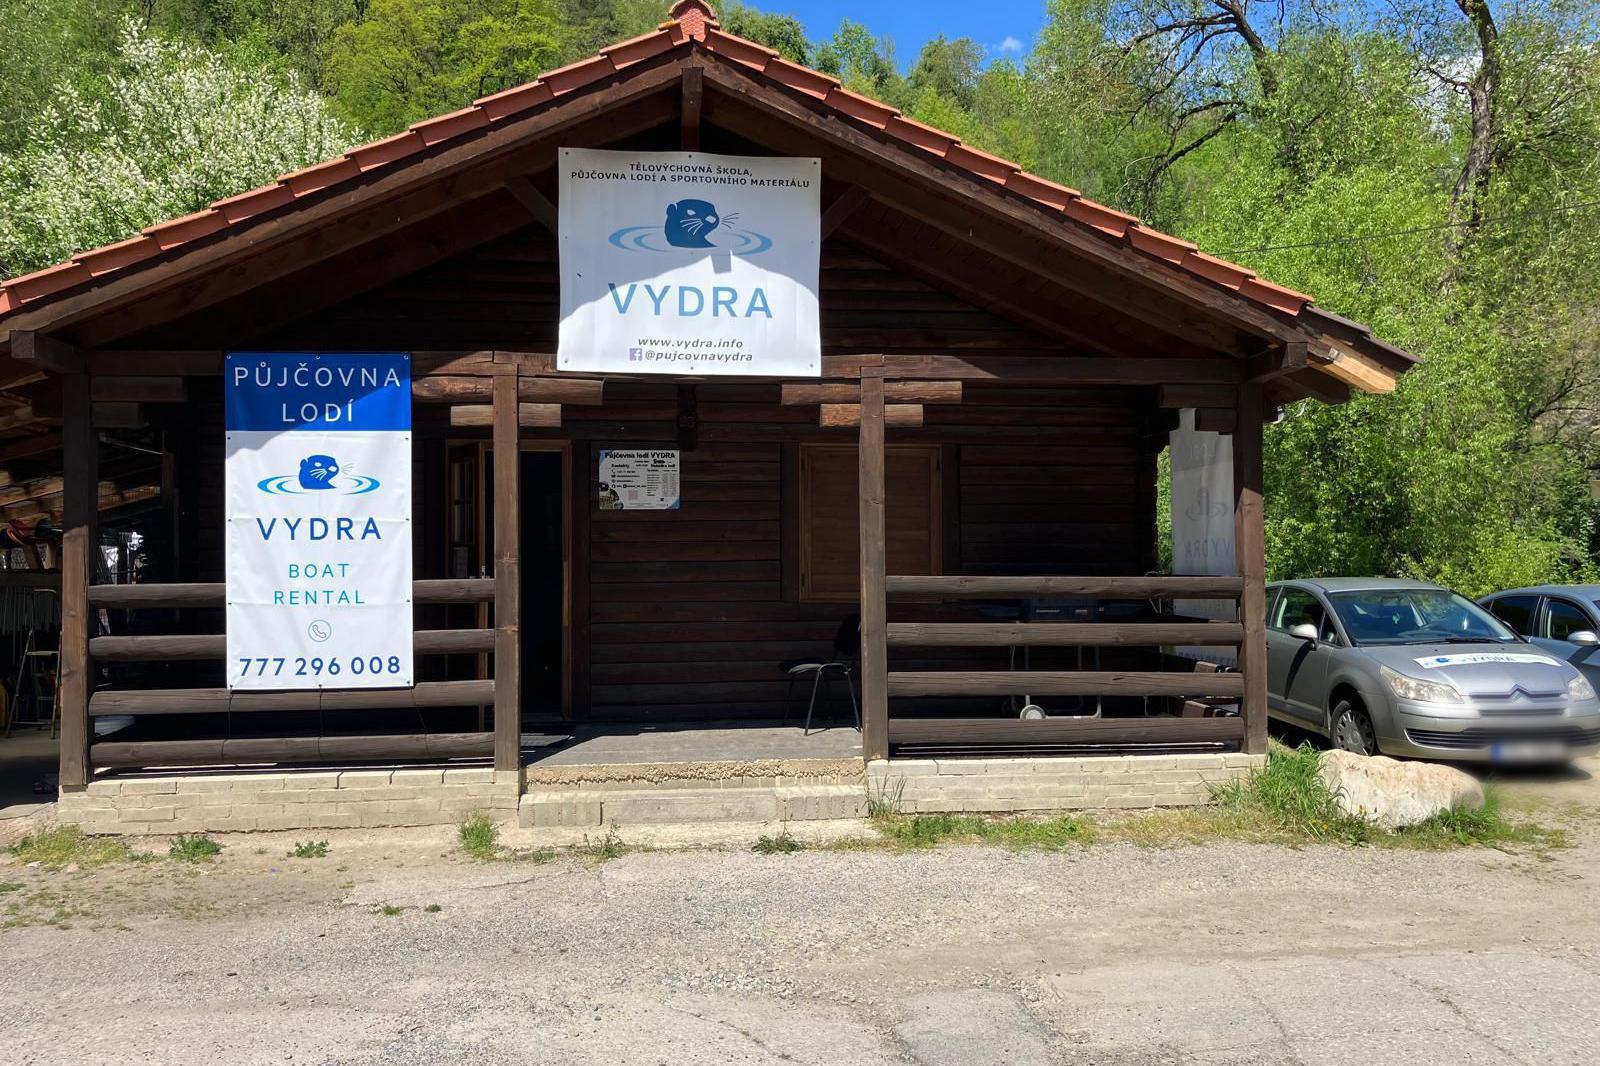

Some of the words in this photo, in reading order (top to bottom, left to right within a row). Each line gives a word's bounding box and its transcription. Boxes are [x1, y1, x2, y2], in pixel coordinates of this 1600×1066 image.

[571, 169, 627, 180] PŮJČOVNA
[630, 173, 657, 182] LODÍ
[660, 174, 667, 182] A
[670, 174, 747, 185] SPORTOVNÍHO
[750, 178, 810, 188] MATERIÁLU
[629, 162, 713, 174] TĚLOVÝCHOVNÁ
[716, 165, 753, 177] ŠKOLA,
[607, 282, 774, 319] VYDRA
[637, 337, 744, 349] www.vydra.info
[645, 349, 753, 362] @pujcovnavydra
[234, 361, 400, 387] PŮJČOVNA
[282, 399, 354, 423] LODÍ
[256, 517, 382, 541] VYDRA
[288, 563, 350, 579] BOAT
[274, 589, 366, 606] RENTAL
[239, 657, 286, 677] 777
[294, 657, 341, 676] 296
[350, 655, 401, 675] 008
